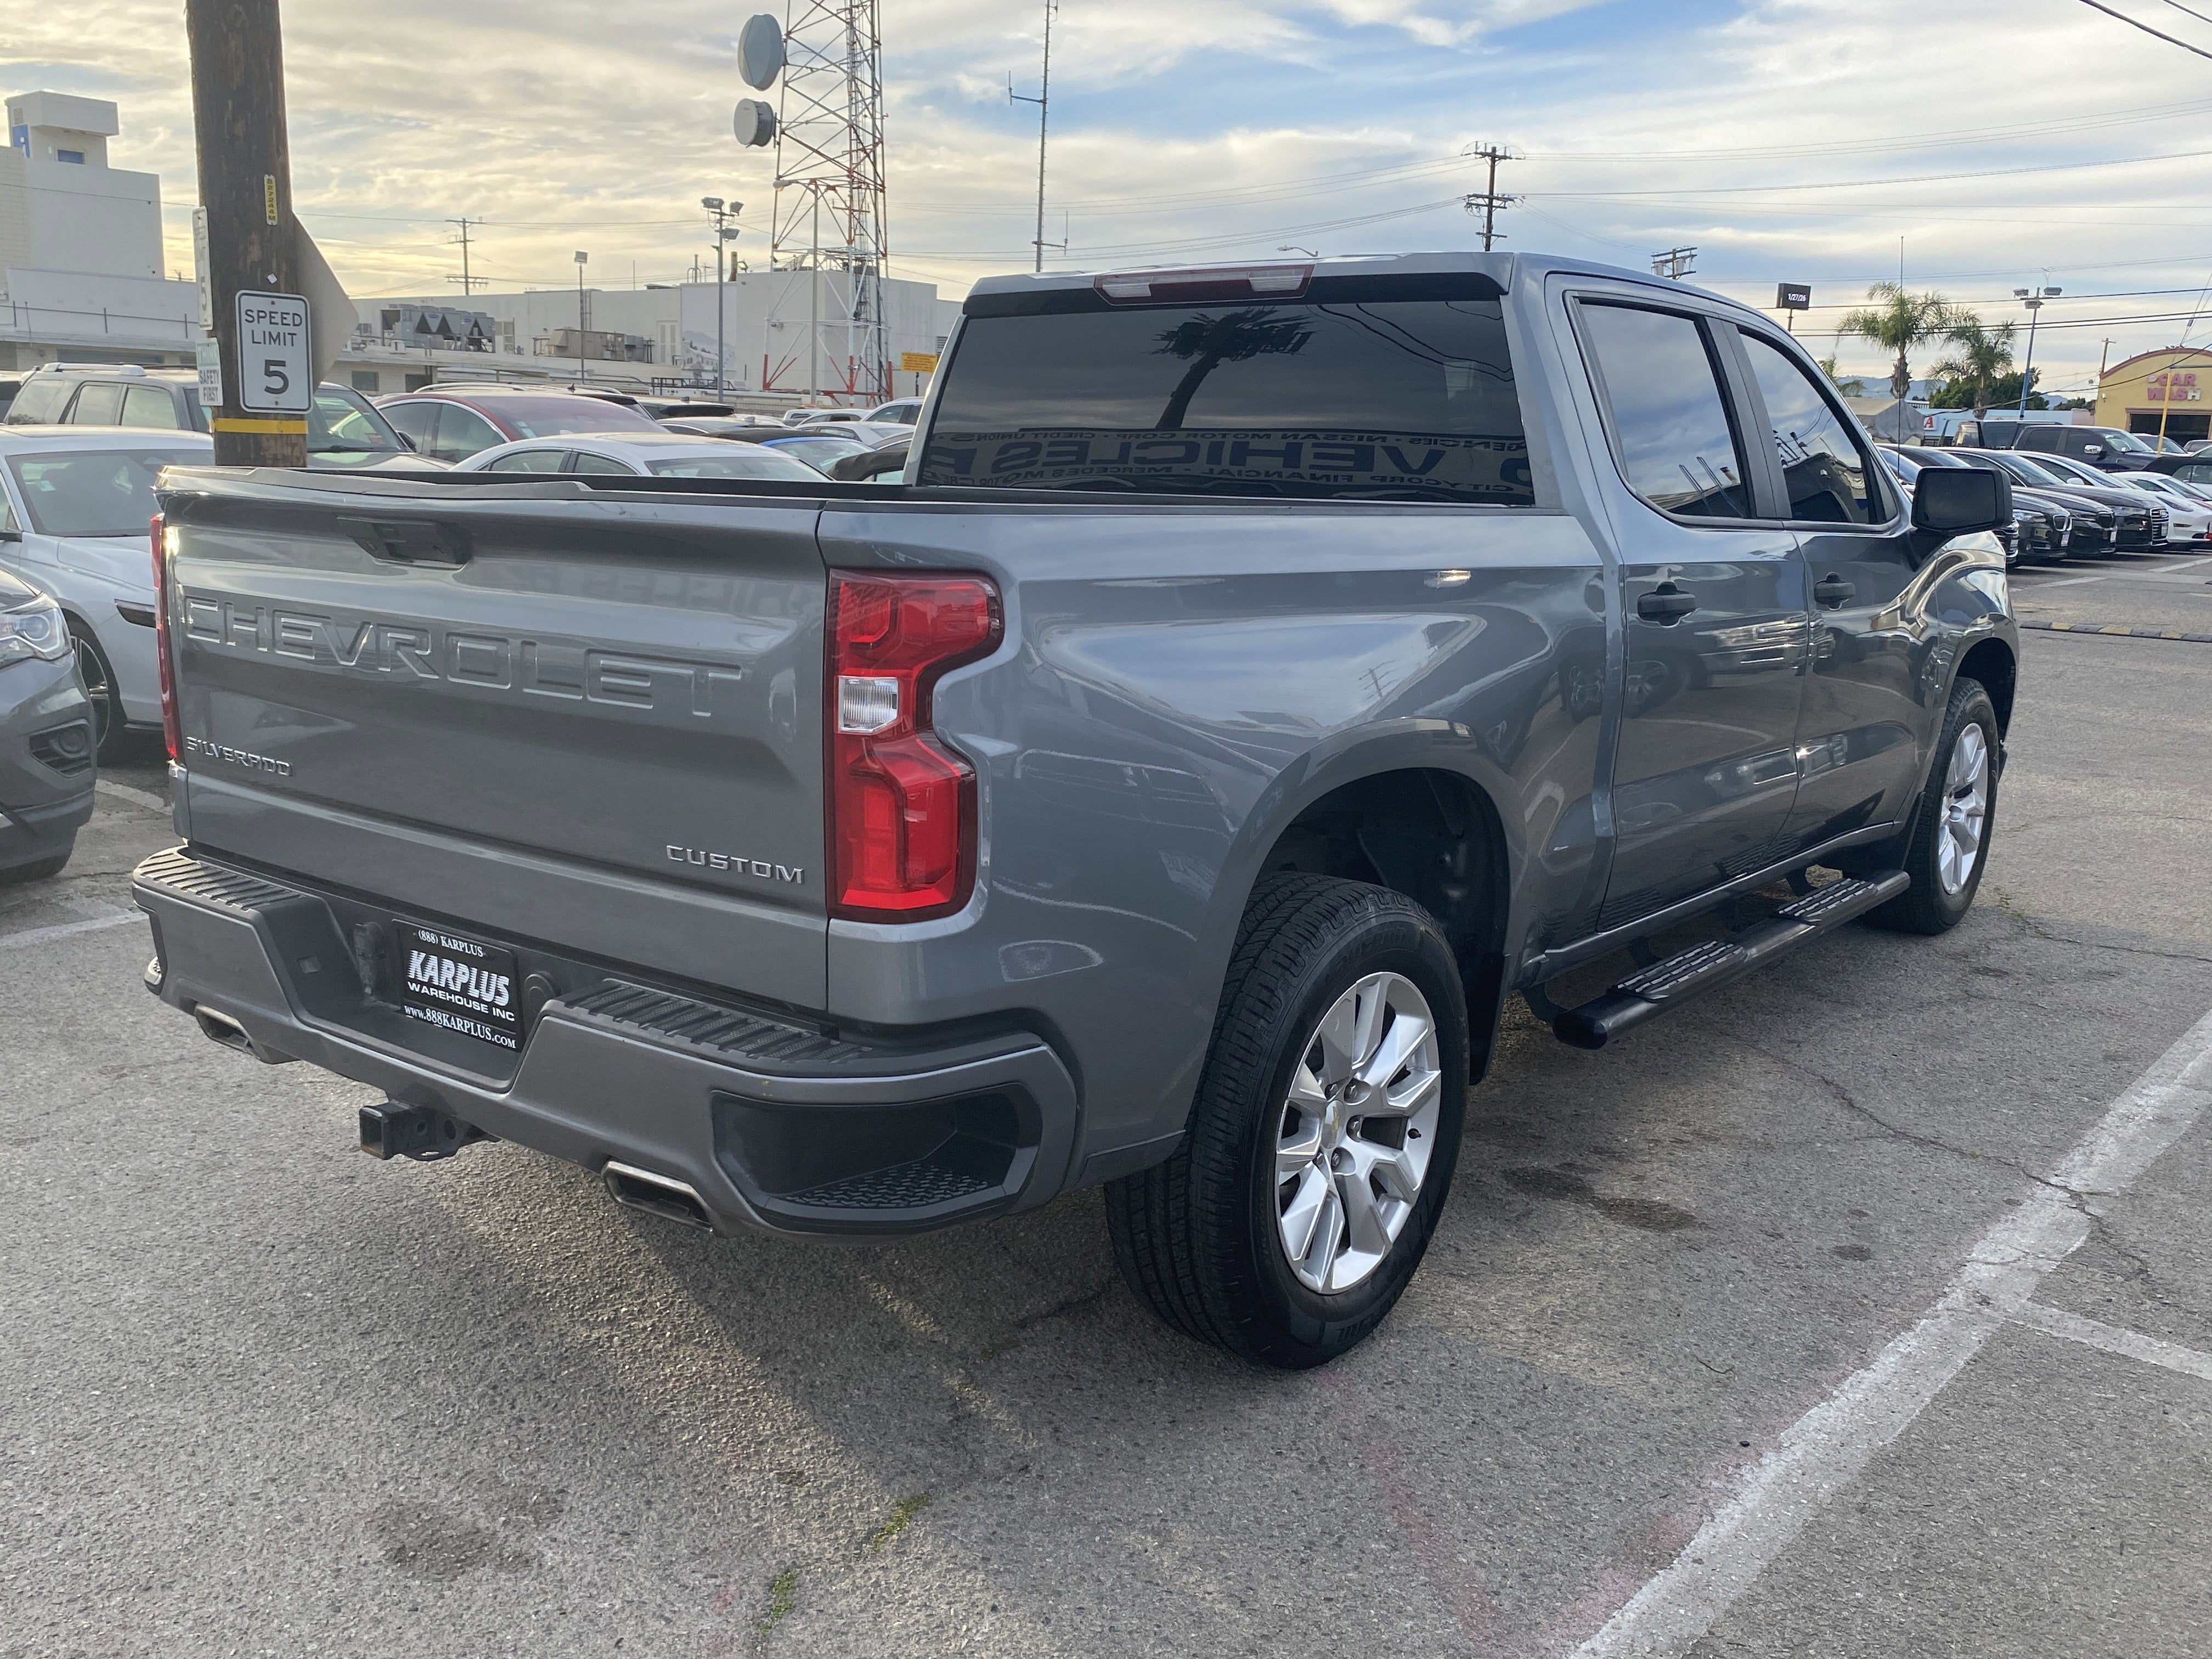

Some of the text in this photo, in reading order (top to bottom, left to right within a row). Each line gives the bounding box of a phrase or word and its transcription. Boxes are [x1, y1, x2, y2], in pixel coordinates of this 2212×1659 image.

[1788, 293, 1806, 302] 1/27/26
[245, 309, 303, 327] SPEED
[251, 330, 297, 347] LIMIT
[199, 370, 219, 384] SAFETY
[263, 359, 289, 394] 5
[2157, 373, 2196, 386] CAR
[204, 387, 218, 402] FIRST
[183, 595, 743, 718] CHEVROLET
[187, 736, 293, 776] SILVERADO
[666, 845, 804, 884] CUSTOM
[418, 929, 483, 957] (888) KARPLUS
[407, 950, 509, 1006] KARPLUS
[408, 981, 515, 1022] WAREHOUSE INC
